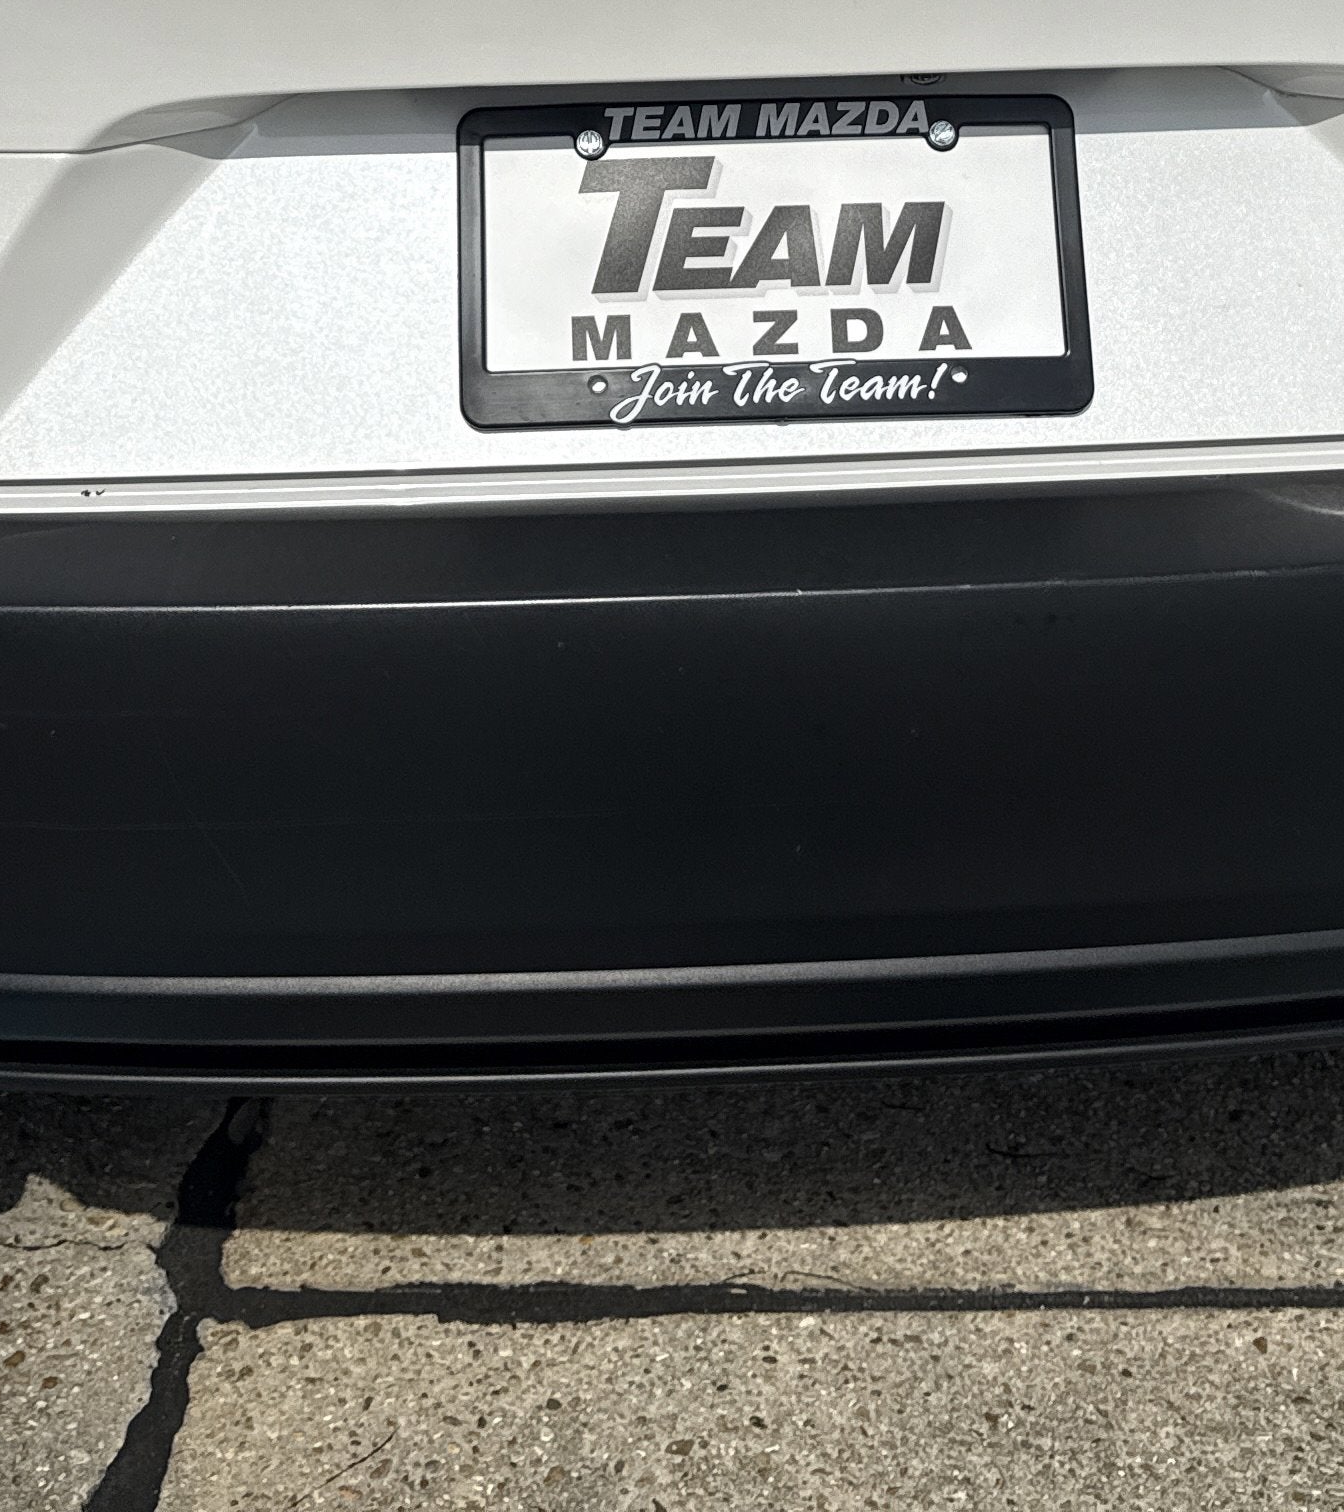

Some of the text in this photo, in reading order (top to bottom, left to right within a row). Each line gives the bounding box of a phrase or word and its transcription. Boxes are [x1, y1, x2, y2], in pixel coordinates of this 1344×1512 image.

[603, 99, 930, 142] TEAM MAZDA
[572, 306, 972, 361] MAZDA
[610, 359, 950, 424] Join The Team!
